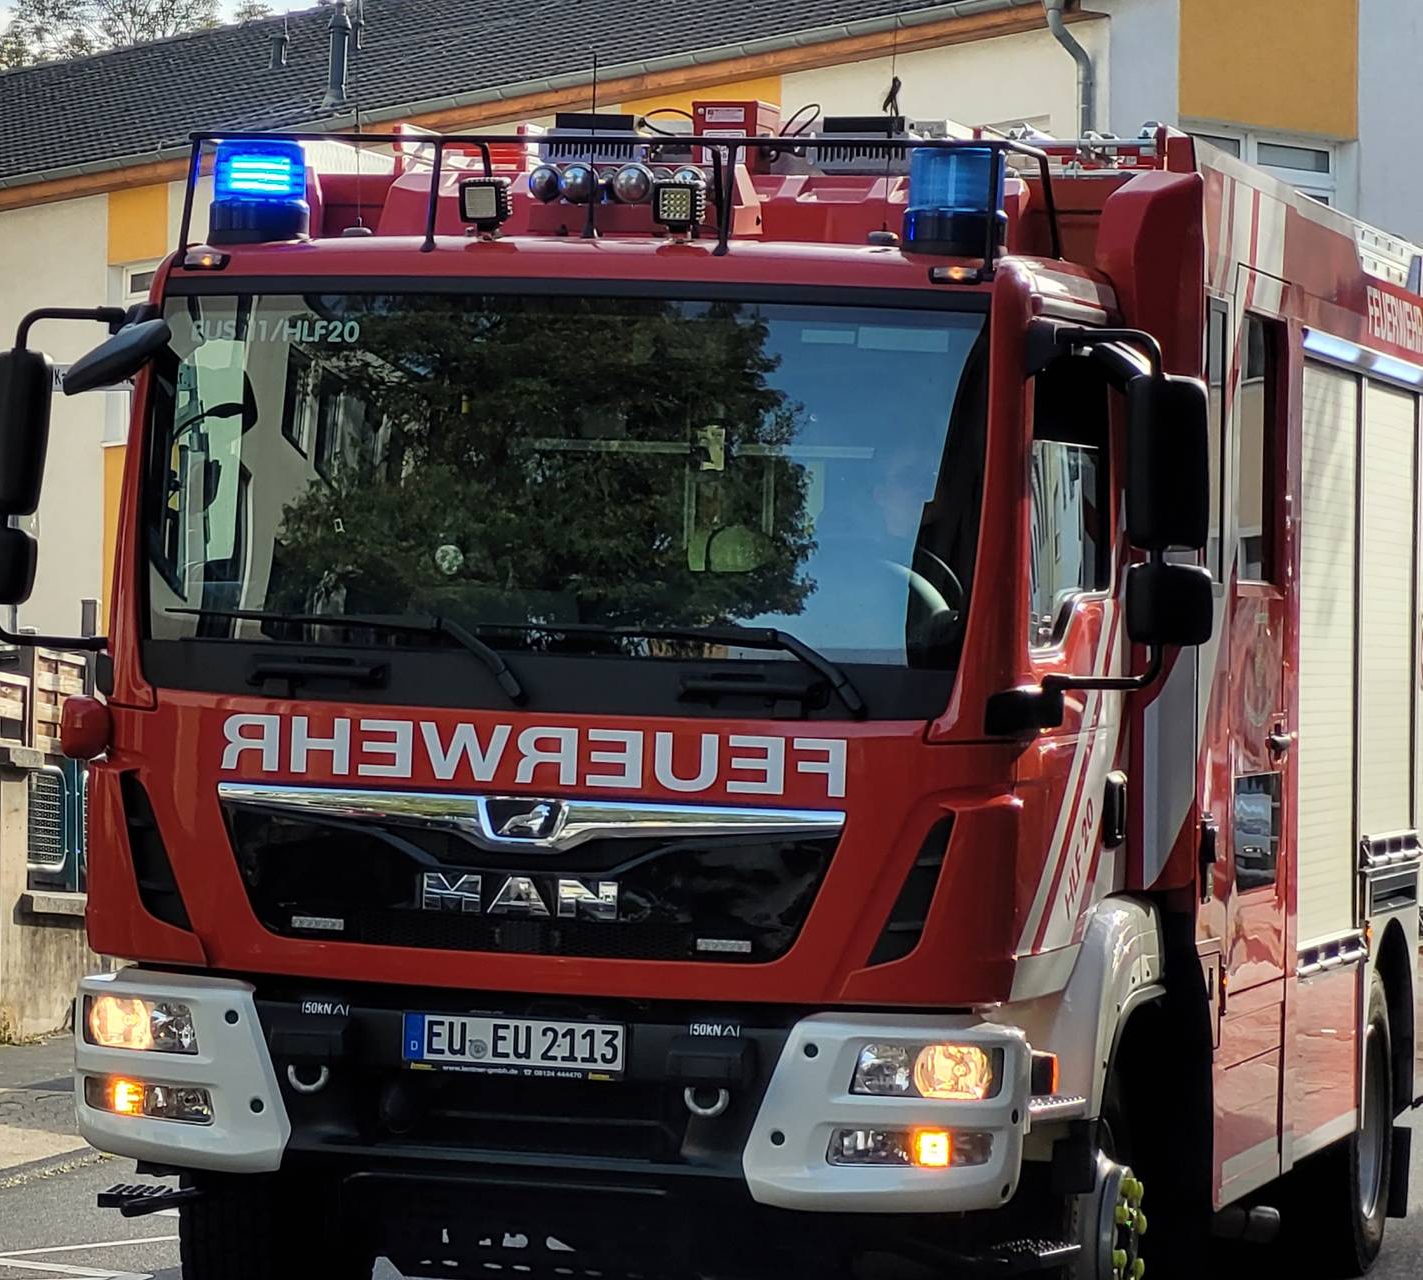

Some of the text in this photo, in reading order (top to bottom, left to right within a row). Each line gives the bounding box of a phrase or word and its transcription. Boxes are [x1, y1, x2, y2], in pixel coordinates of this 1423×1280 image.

[1366, 285, 1423, 354] FEUERWEHR
[1081, 797, 1094, 852] 20
[421, 872, 621, 920] MAN
[410, 1020, 619, 1065] D EU EU 2113
